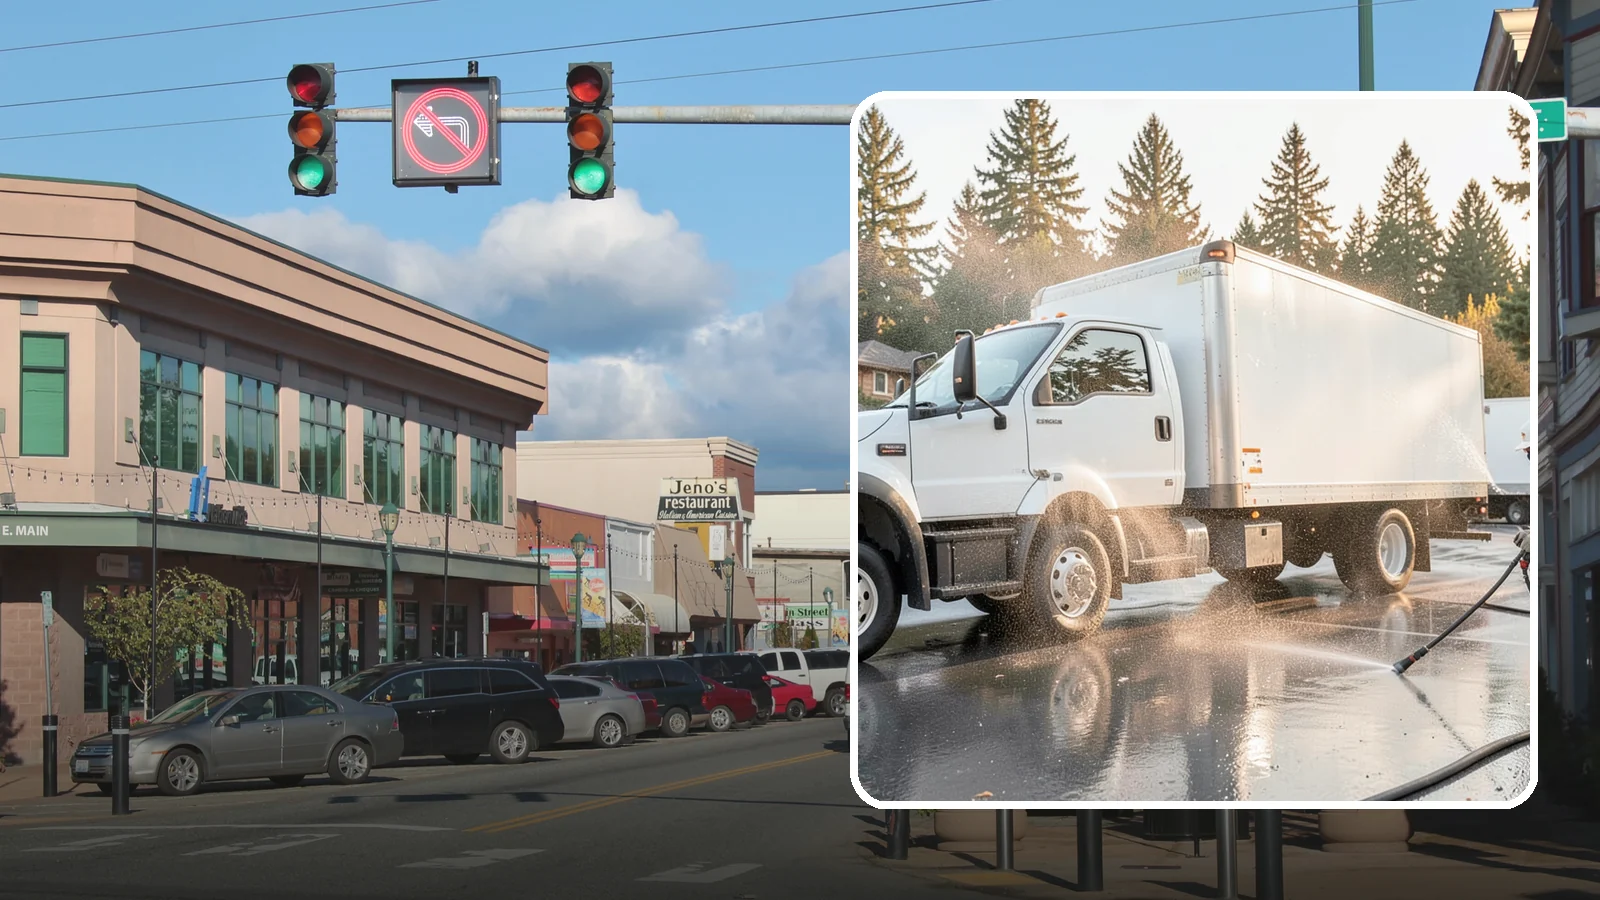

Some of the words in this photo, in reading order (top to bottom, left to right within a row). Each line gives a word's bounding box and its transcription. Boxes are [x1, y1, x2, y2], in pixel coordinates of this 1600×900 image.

[670, 480, 727, 494] Jeno's
[665, 496, 731, 508] restaurant
[2, 525, 13, 536] E.
[15, 525, 49, 536] MAIN
[797, 608, 828, 616] Street
